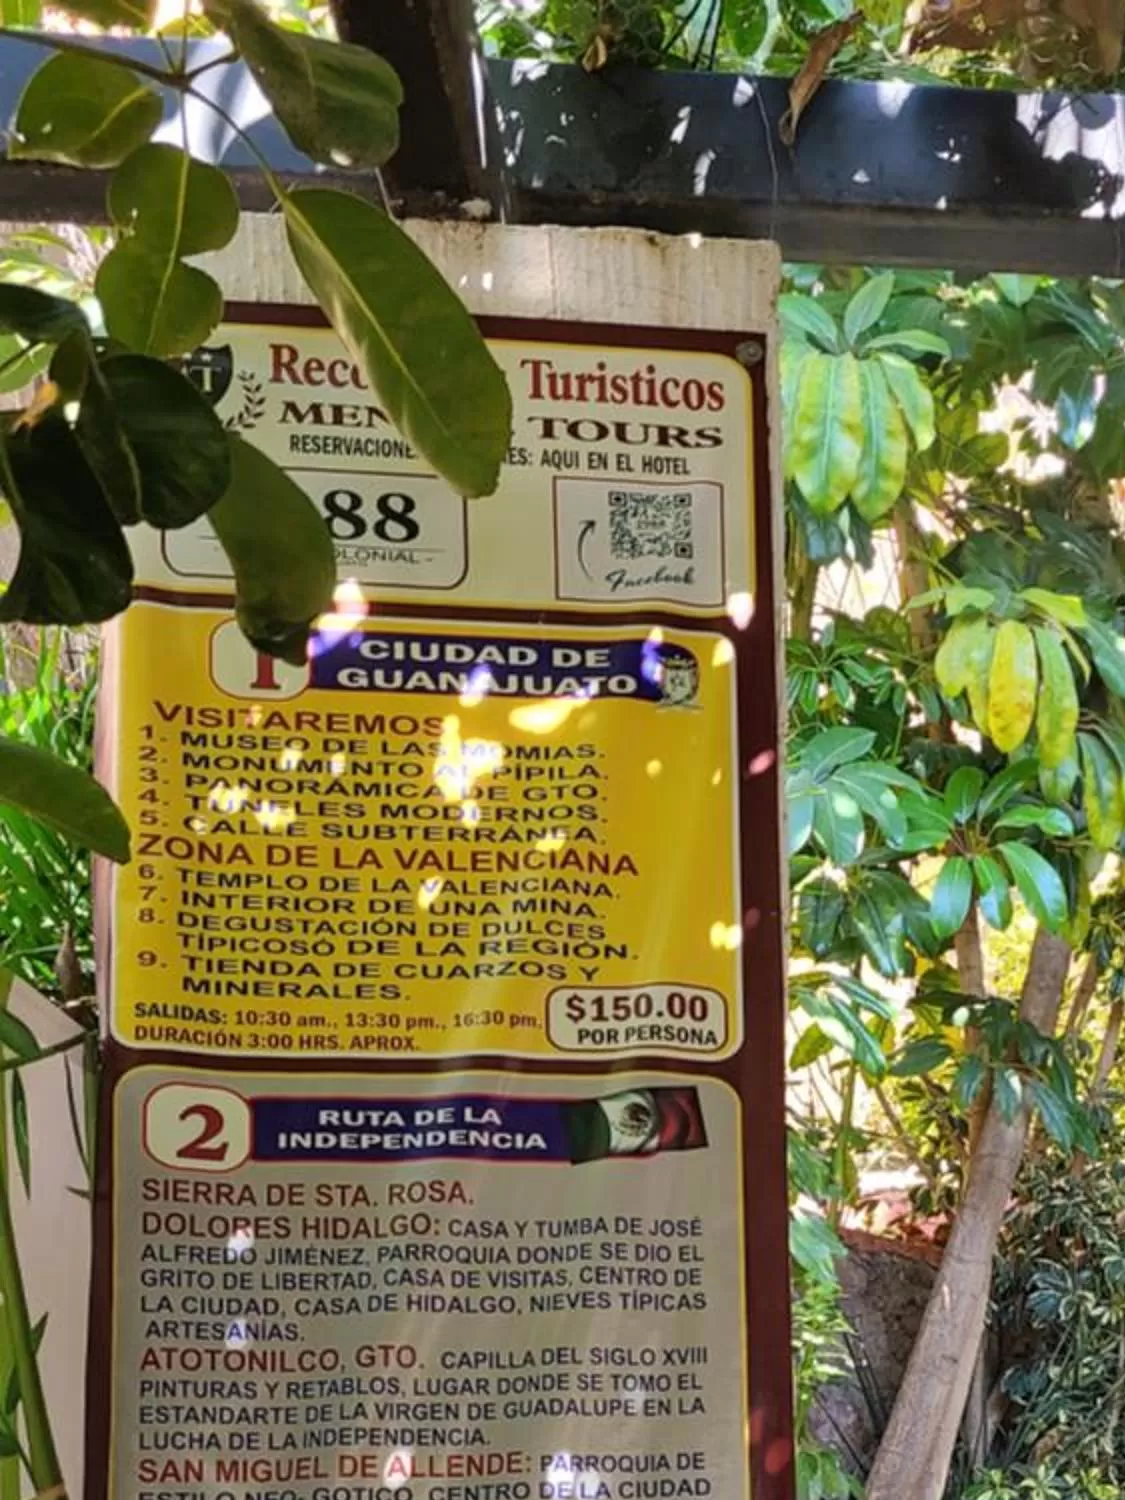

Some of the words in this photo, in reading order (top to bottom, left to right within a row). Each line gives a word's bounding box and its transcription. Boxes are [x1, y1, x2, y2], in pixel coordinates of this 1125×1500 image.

[520, 359, 724, 412] Turisticos
[279, 401, 391, 429] MEN
[528, 416, 723, 448] TOURS
[290, 434, 416, 458] RESERVACIONE
[540, 450, 579, 470] AQUI
[588, 452, 608, 470] EN
[616, 454, 634, 472] EL
[642, 456, 690, 474] HOTEL
[359, 640, 537, 666] CIUDAD
[552, 648, 610, 667] DE
[337, 667, 637, 695] GUANAJUATO
[153, 701, 444, 737] VISITAREMOS
[138, 834, 254, 865] ZONA
[267, 845, 318, 867] DE
[334, 848, 382, 870] LA
[394, 849, 639, 877] VALENCIANA
[176, 868, 308, 890] TEMPLO
[320, 876, 360, 892] DE
[372, 879, 410, 892] LA
[181, 890, 354, 913] INTERIOR
[369, 900, 416, 914] DE
[430, 901, 500, 916] UNA
[512, 899, 605, 918] MINA.
[177, 912, 416, 936] DEGUSTACIÓN
[429, 922, 469, 937] DE
[482, 920, 605, 939] DULCES
[180, 955, 321, 976] TIENDA
[333, 963, 381, 978] DE
[394, 961, 567, 981] CUARZOS
[580, 967, 600, 981] Y
[181, 976, 410, 1000] MINERALES.
[134, 1002, 228, 1024] SALIDAS:
[235, 1011, 290, 1026] 10:30
[346, 1012, 400, 1028] 13:30
[453, 1010, 504, 1027] 16:30
[566, 991, 709, 1022] $150.00
[134, 1026, 241, 1048] DURACIÓN
[248, 1033, 292, 1048] 3:00
[300, 1035, 345, 1050] HRS.
[350, 1035, 420, 1051] APROX.
[578, 1029, 619, 1045] POR
[624, 1025, 717, 1046] PERSONA
[319, 1110, 404, 1126] RUTA
[414, 1108, 454, 1124] DE
[464, 1107, 502, 1123] LA
[176, 1104, 229, 1161] 2
[278, 1130, 548, 1149] INDEPENDENCIA
[142, 1179, 256, 1207] SIERRA
[267, 1184, 304, 1206] DE
[316, 1184, 378, 1207] STA.
[388, 1180, 475, 1205] ROSA.
[142, 1212, 290, 1240] DOLORES
[302, 1213, 441, 1240] HIDALGO:
[448, 1219, 511, 1239] CASA
[513, 1221, 527, 1238] Y
[535, 1216, 608, 1238] TUMBA
[614, 1216, 642, 1235] DE
[140, 1296, 172, 1313] LA
[182, 1296, 286, 1318] CIUDAD,
[295, 1298, 361, 1316] CASA
[368, 1294, 398, 1312] DE
[406, 1295, 522, 1315] HIDALGO,
[530, 1291, 611, 1312] NIEVES
[620, 1289, 706, 1311] TÍPICAS
[146, 1320, 304, 1342] ARTESANÍAS.
[140, 1347, 346, 1373] ATOTONILCO,
[441, 1350, 536, 1369] CAPILLA
[541, 1348, 582, 1365] DEL
[590, 1348, 656, 1366] SIGLO
[662, 1347, 707, 1365] XVIII
[139, 1432, 221, 1450] LUCHA
[229, 1432, 260, 1450] DE
[269, 1431, 298, 1450] LA
[303, 1427, 490, 1448] INDEPENDENCIA.
